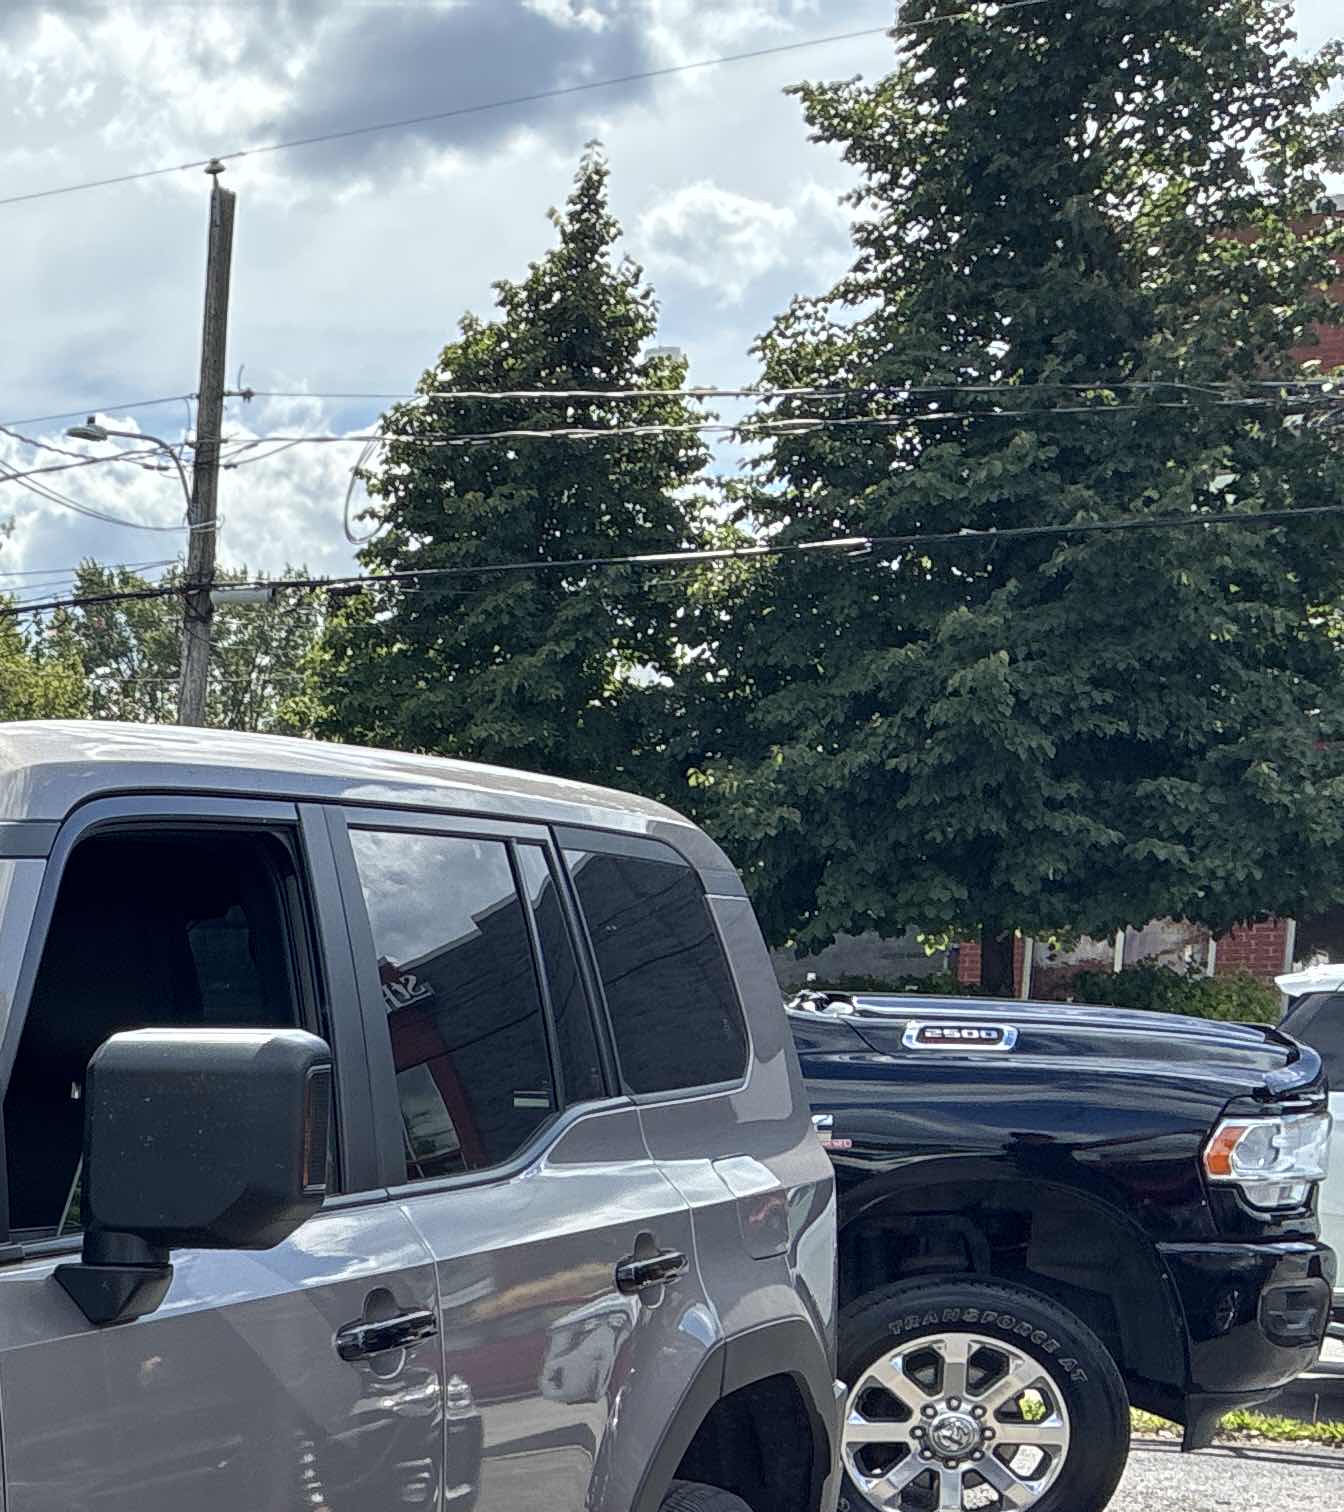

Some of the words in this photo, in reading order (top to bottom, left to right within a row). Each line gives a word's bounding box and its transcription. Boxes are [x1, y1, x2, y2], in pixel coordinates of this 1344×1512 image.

[924, 1028, 999, 1039] 2500
[888, 1308, 1062, 1353] TRANSFORCE
[1058, 1357, 1088, 1384] AT
